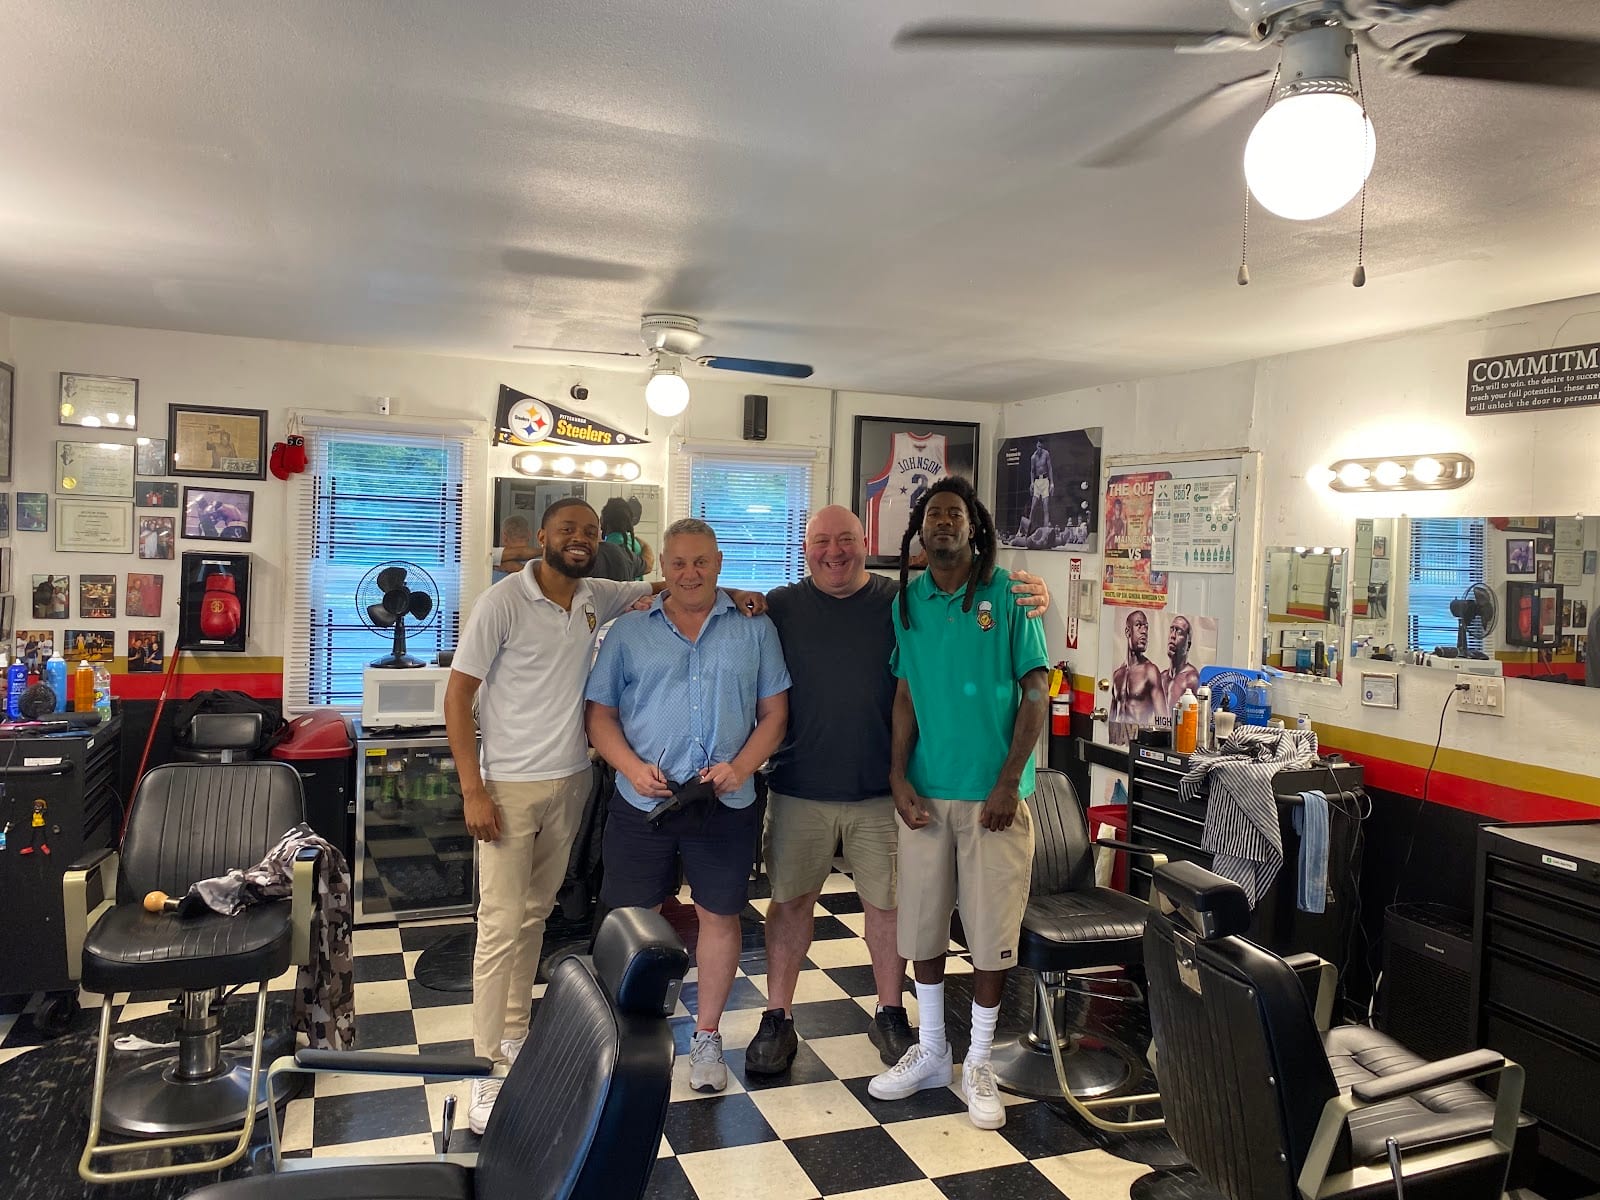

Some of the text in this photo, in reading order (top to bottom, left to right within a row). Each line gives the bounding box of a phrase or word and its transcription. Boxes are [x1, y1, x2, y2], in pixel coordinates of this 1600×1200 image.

[1473, 348, 1599, 382] COMMITM
[1471, 384, 1484, 392] The
[1486, 381, 1500, 390] will
[1527, 378, 1540, 386] the
[1541, 376, 1565, 384] desire
[1471, 393, 1489, 402] reach
[1490, 393, 1507, 402] your
[1508, 389, 1521, 398] full
[1564, 383, 1585, 392] these
[1470, 402, 1485, 411] will
[1487, 400, 1514, 410] unlock
[1516, 399, 1530, 407] the
[1532, 397, 1551, 405] door
[556, 419, 612, 445] Steelers
[898, 456, 942, 475] JOHNSON
[1108, 483, 1129, 497] THE
[1128, 548, 1142, 560] VS
[1155, 716, 1172, 726] HIGH
